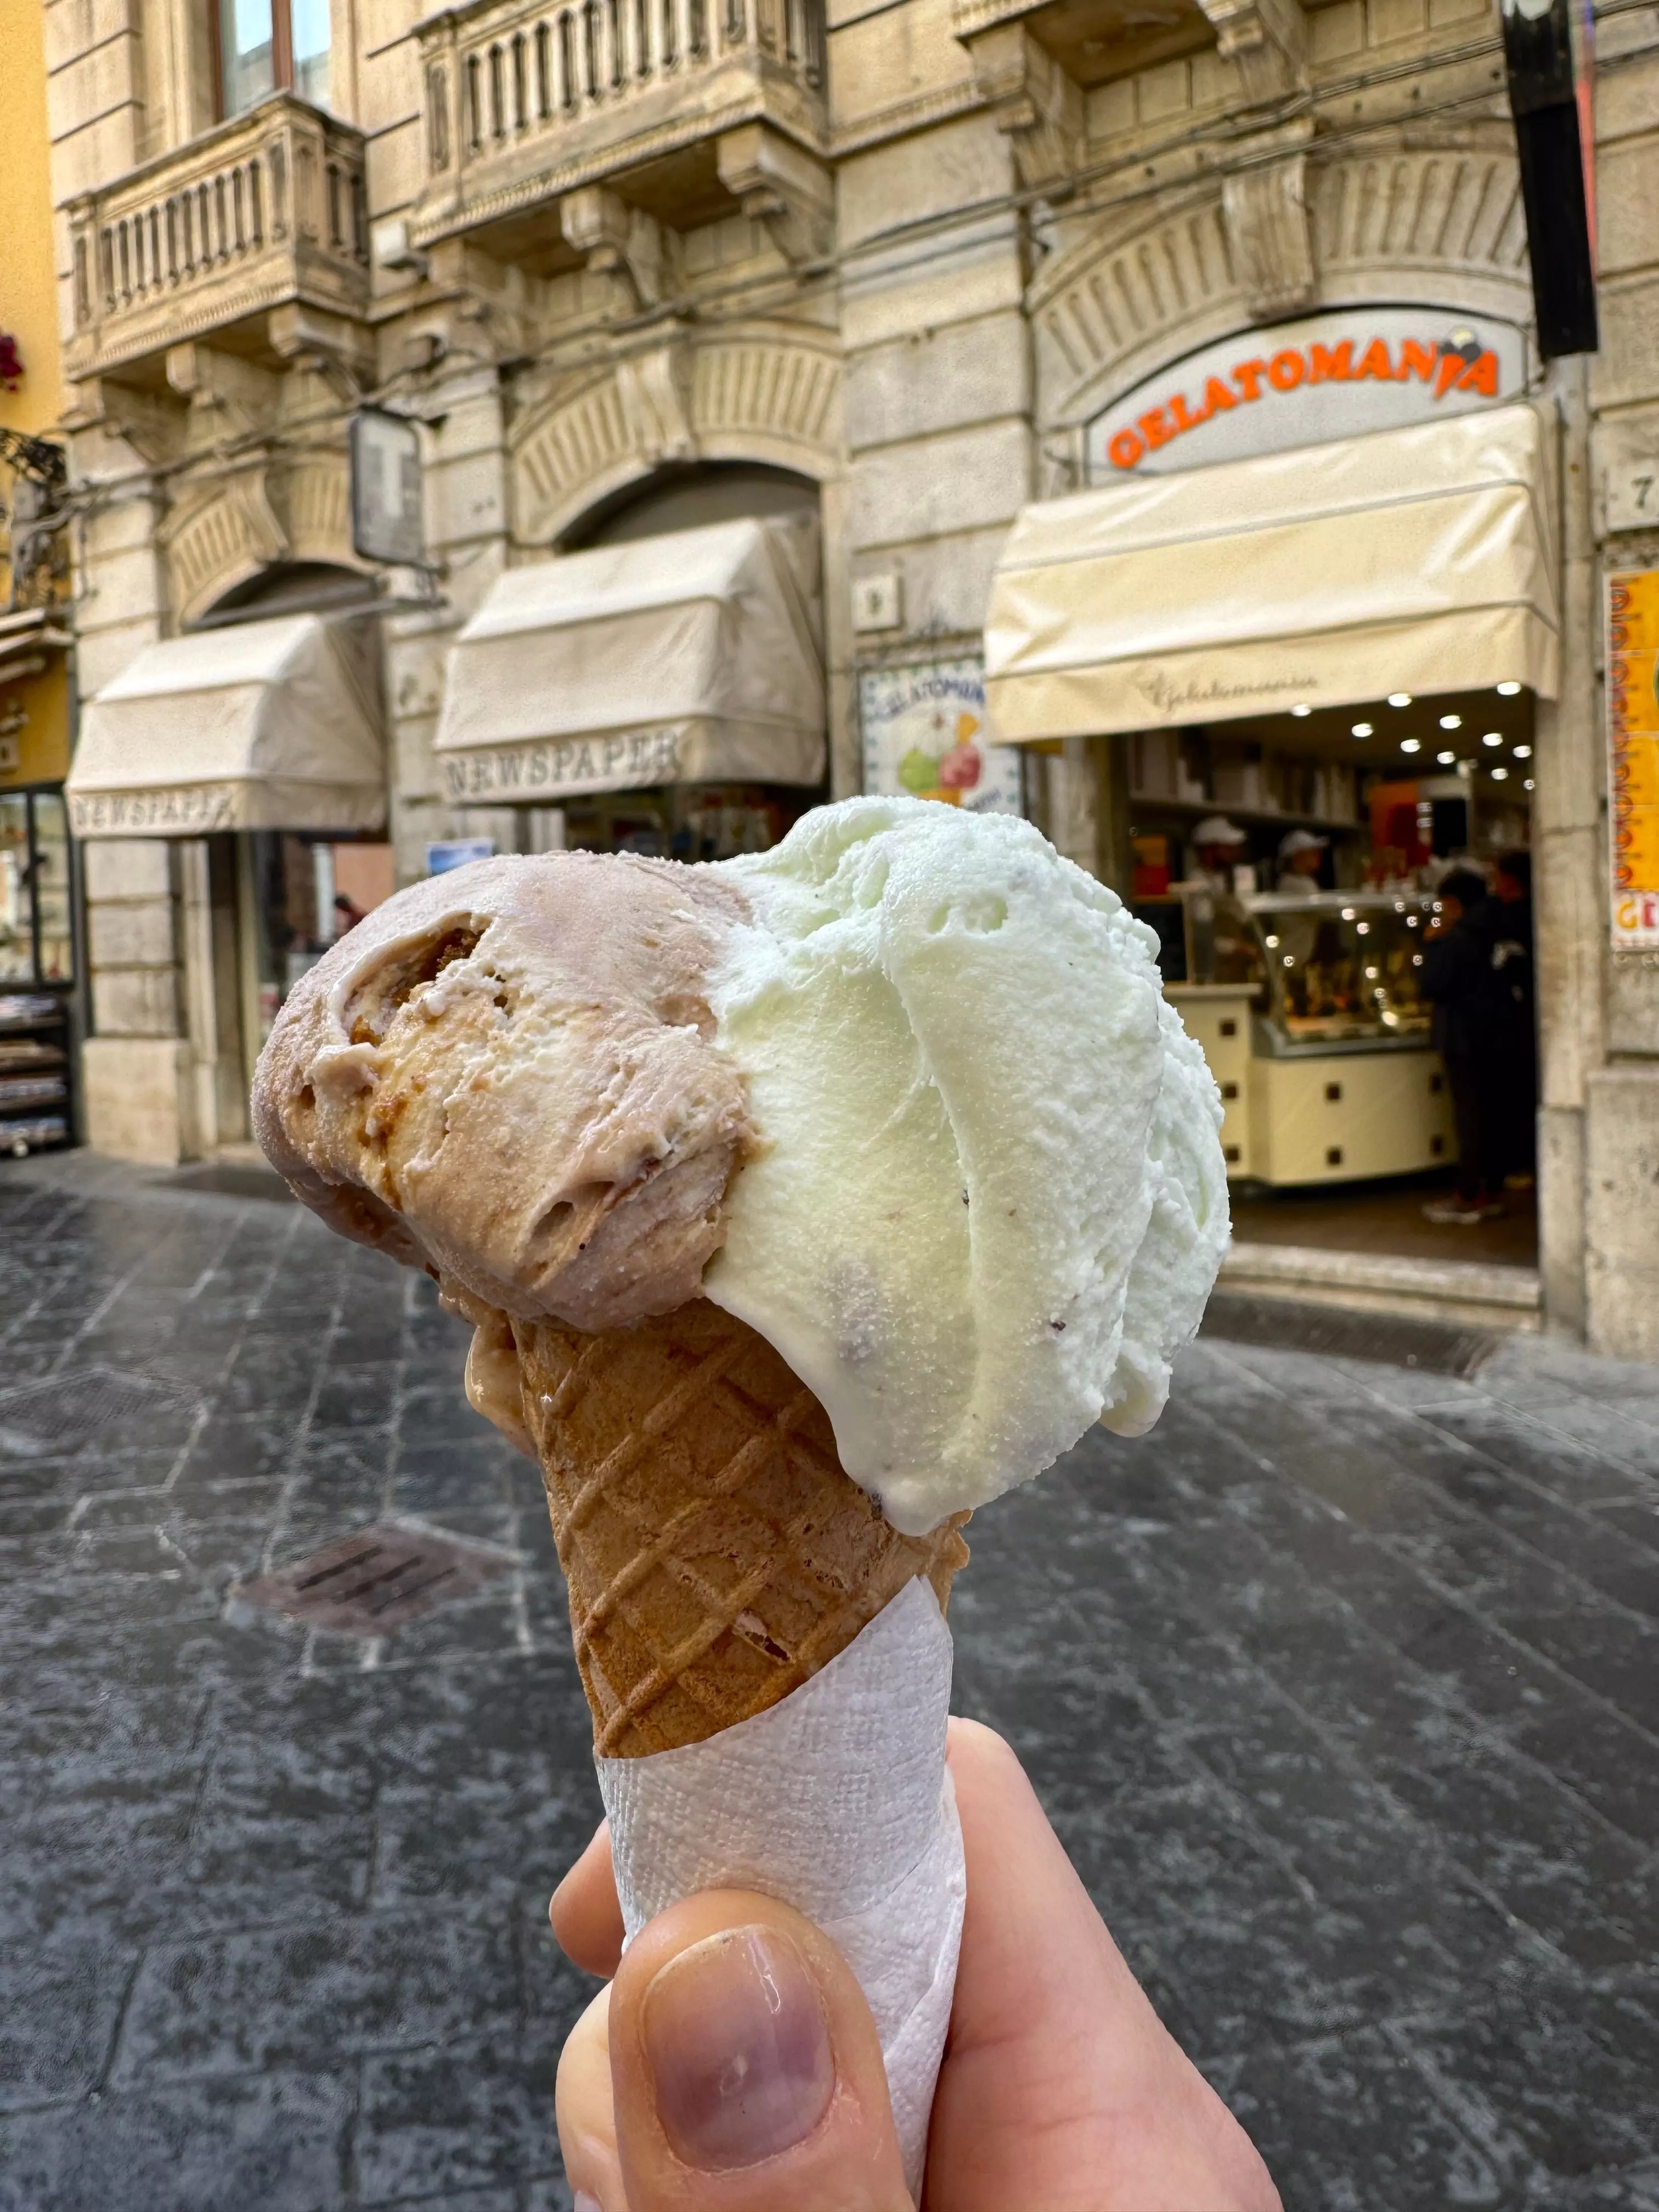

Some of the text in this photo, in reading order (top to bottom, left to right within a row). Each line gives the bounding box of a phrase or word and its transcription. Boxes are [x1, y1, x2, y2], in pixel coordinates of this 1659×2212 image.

[1107, 338, 1499, 470] GELATOMANIA
[1632, 475, 1655, 509] 7
[447, 731, 680, 794] NEWSPAPER
